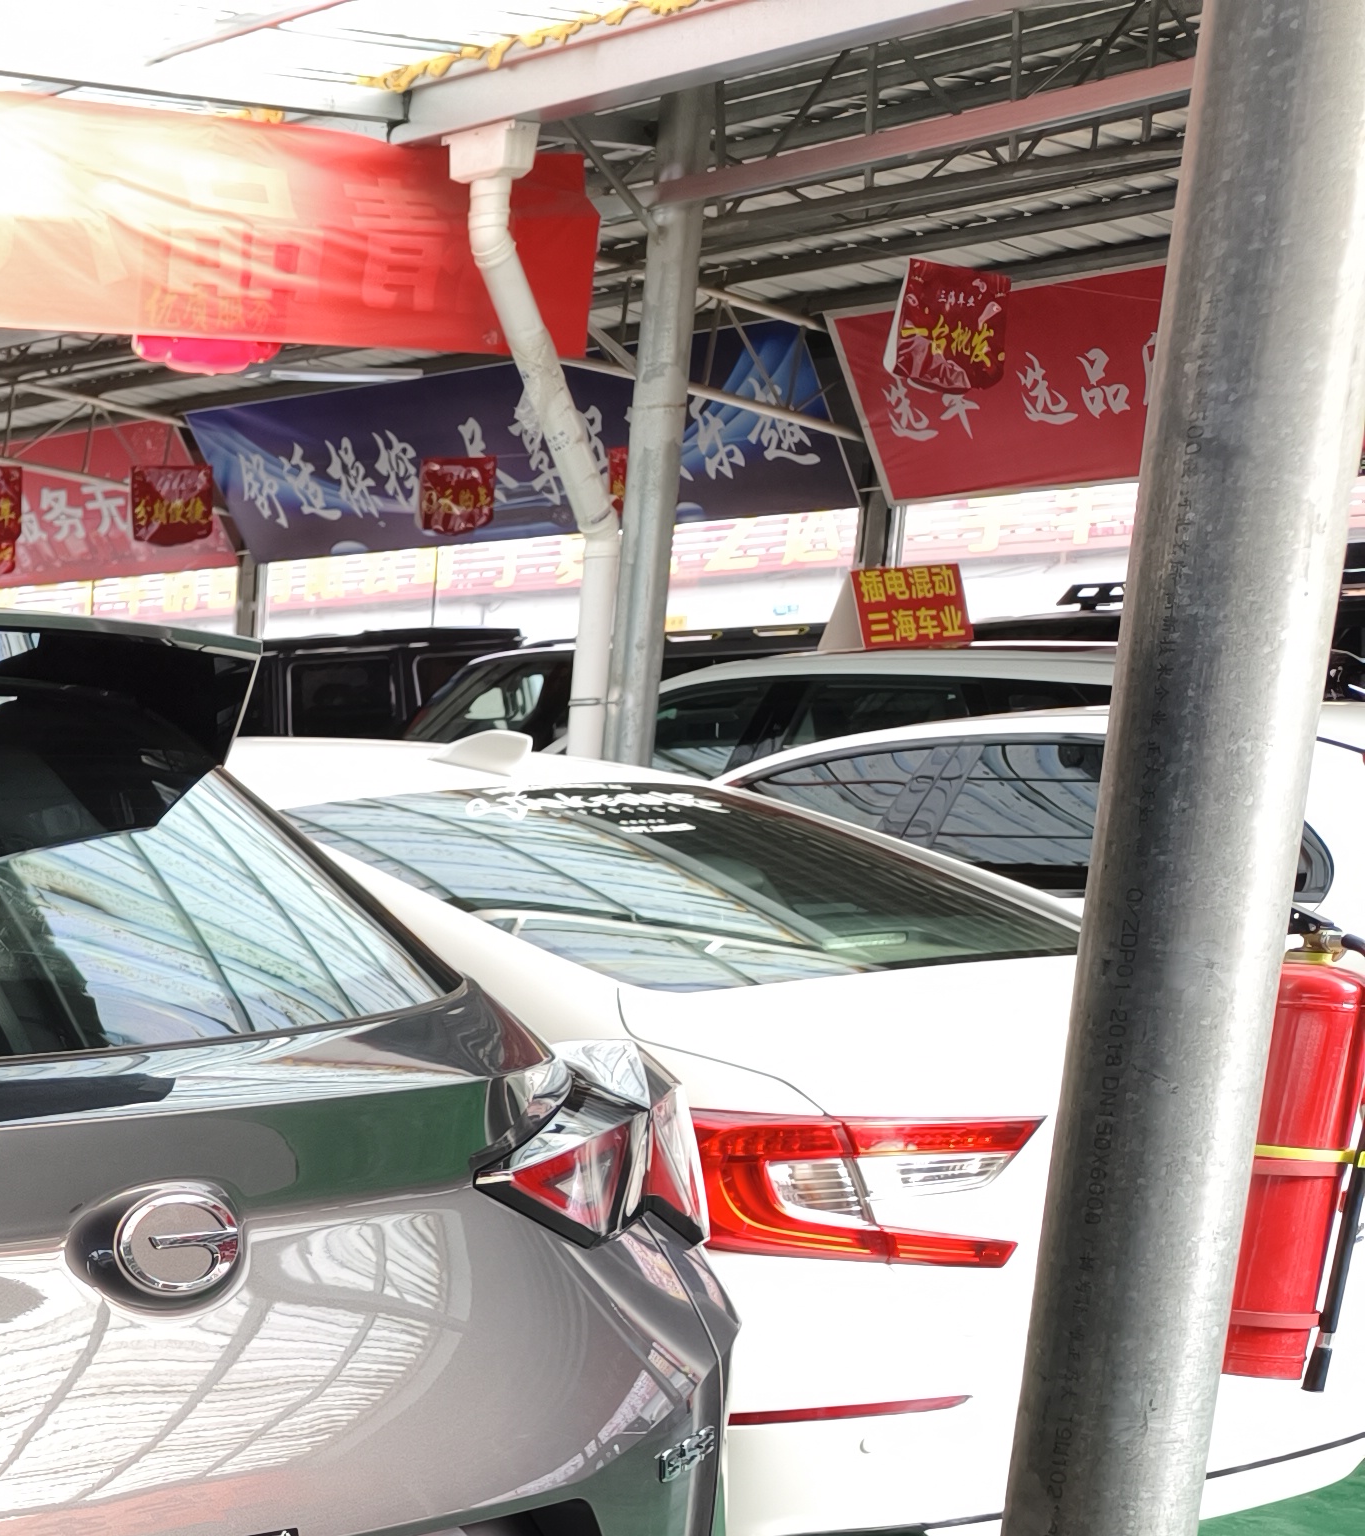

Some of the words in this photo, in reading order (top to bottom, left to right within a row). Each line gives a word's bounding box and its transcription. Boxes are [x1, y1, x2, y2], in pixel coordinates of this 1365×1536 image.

[900, 315, 995, 367] 一台批发
[858, 564, 958, 604] 插电混动
[867, 604, 967, 644] 三海车业
